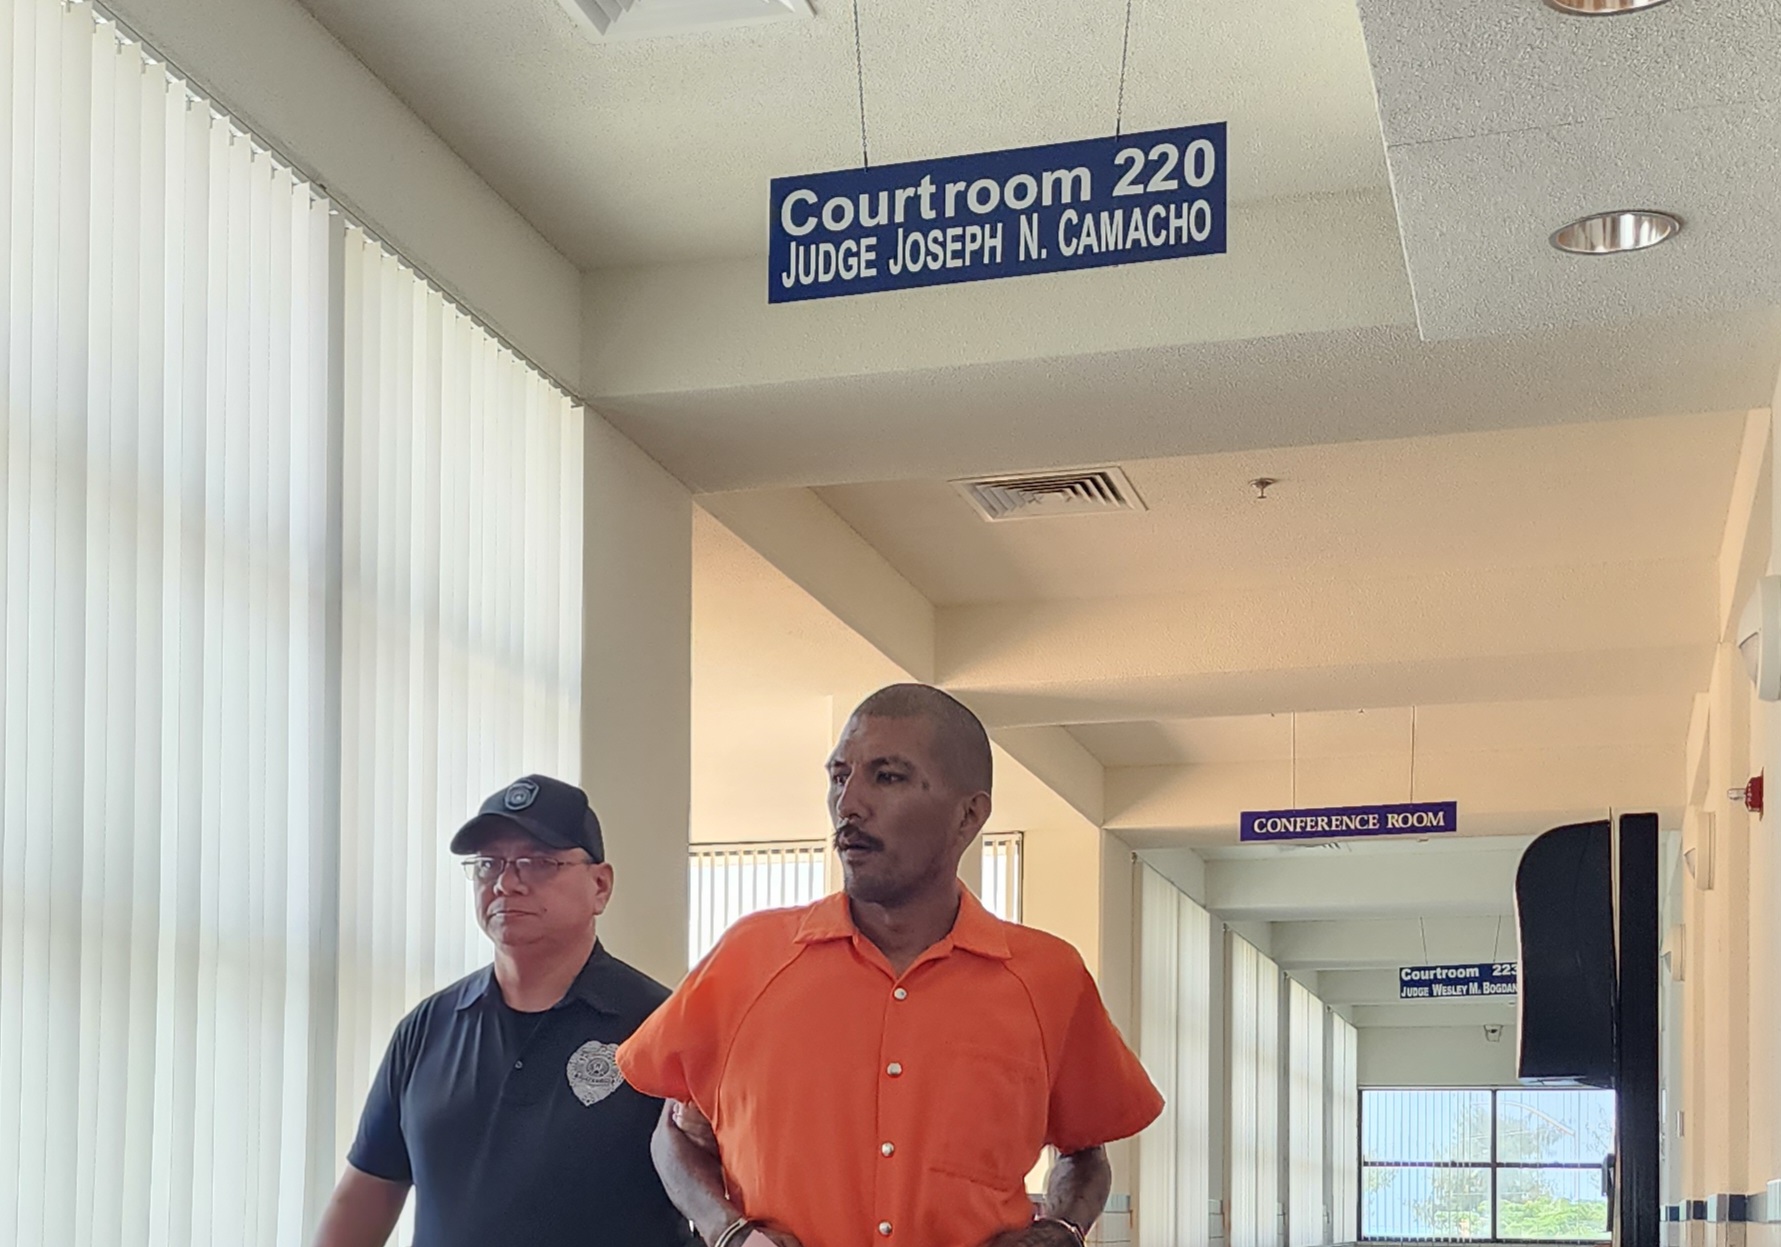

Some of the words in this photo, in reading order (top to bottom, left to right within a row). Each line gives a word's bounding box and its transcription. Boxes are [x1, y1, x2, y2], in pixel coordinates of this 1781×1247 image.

[781, 166, 1091, 236] Courtroom
[1112, 139, 1215, 197] 220
[782, 237, 877, 288] JUDGE
[889, 223, 1002, 275] JOSEPH
[1019, 213, 1047, 261] N.
[1058, 200, 1212, 257] CAMACHO
[1253, 814, 1379, 833] CONFERENCE
[1387, 811, 1445, 828] ROOM
[1401, 967, 1479, 980] Courtroom
[1401, 986, 1429, 997] JUDGE
[1432, 983, 1467, 996] WESLEY
[1469, 982, 1481, 994] M.
